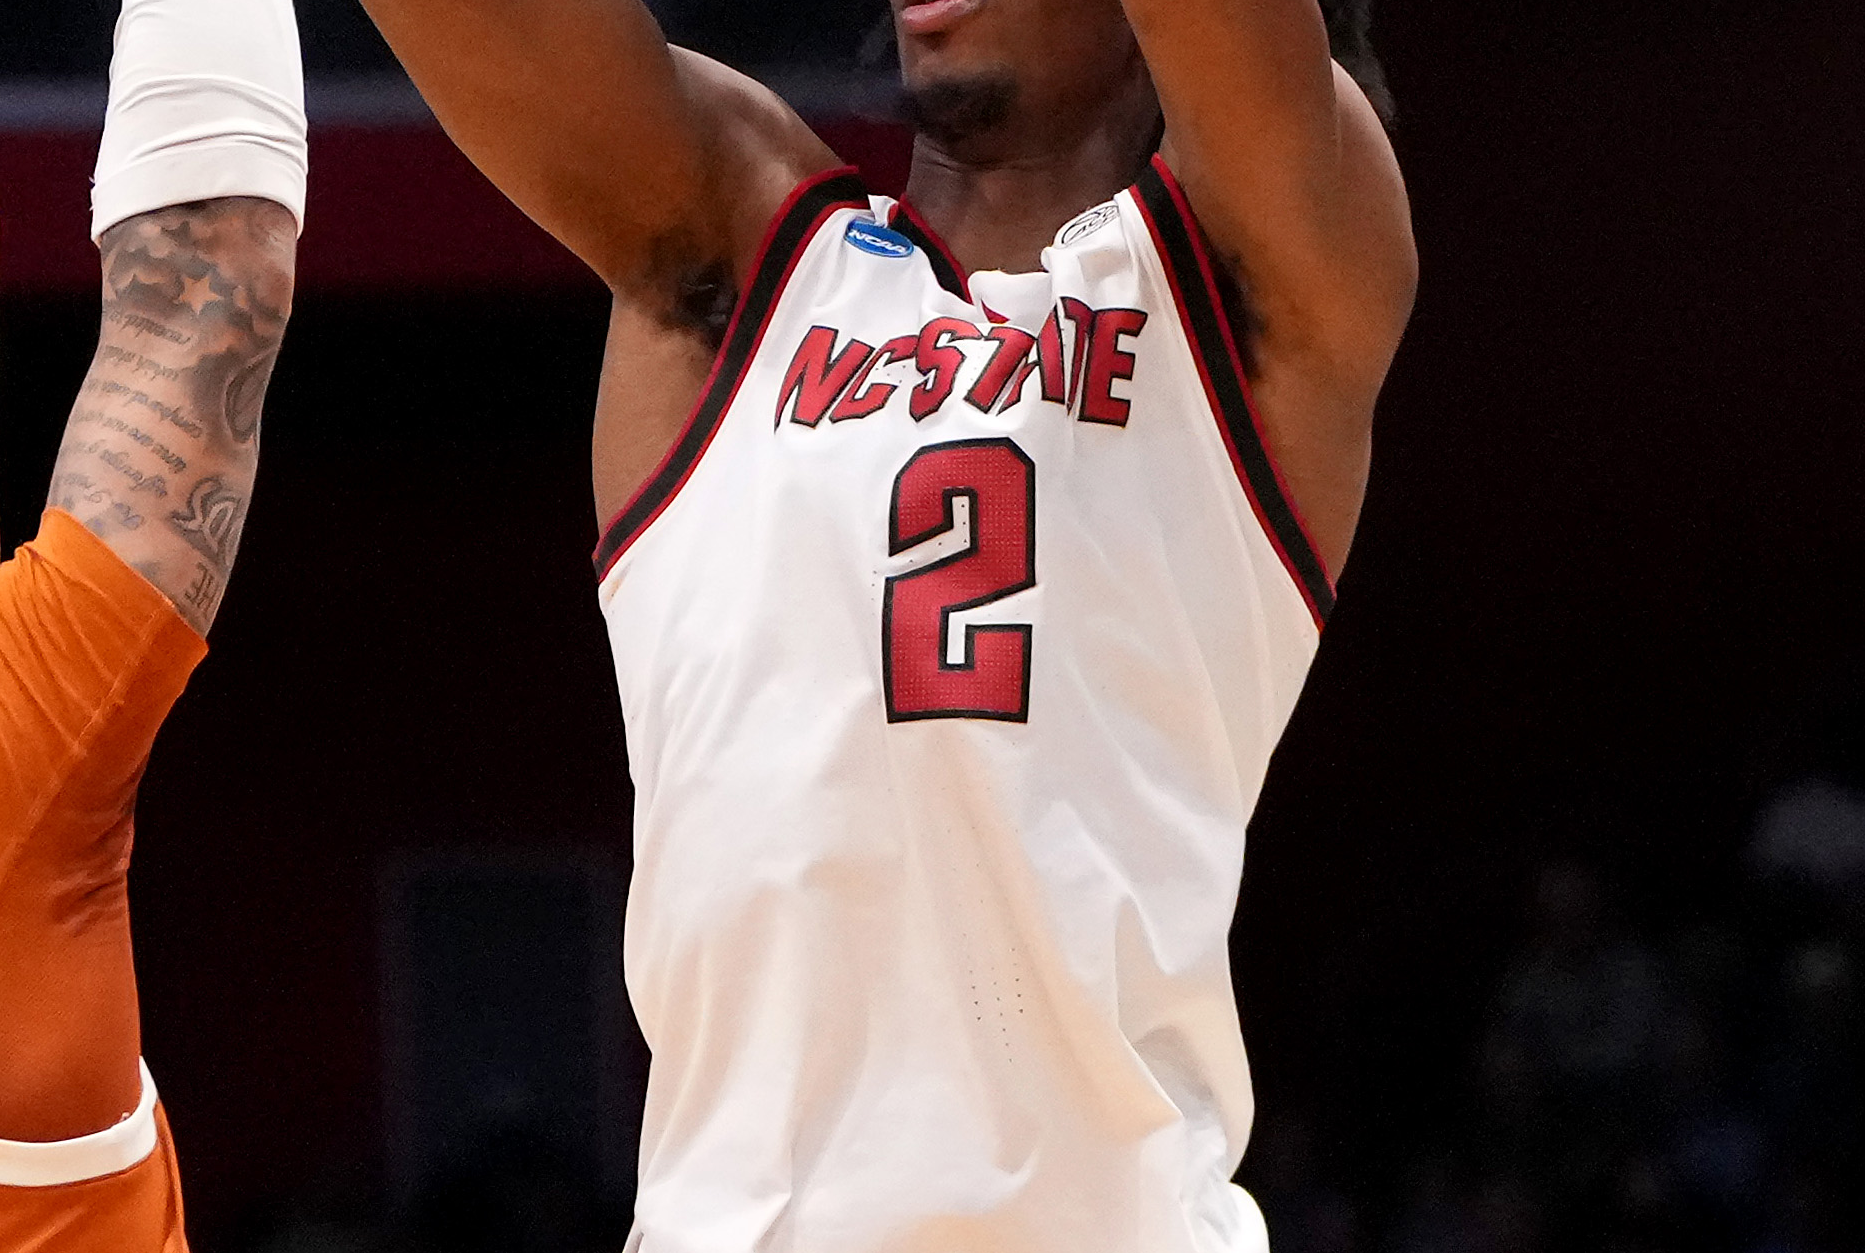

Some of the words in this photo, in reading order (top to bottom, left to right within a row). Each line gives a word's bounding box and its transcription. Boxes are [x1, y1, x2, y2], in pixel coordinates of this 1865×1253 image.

[774, 325, 918, 434] NC
[909, 296, 1148, 428] STATE
[882, 437, 1037, 723] 2
